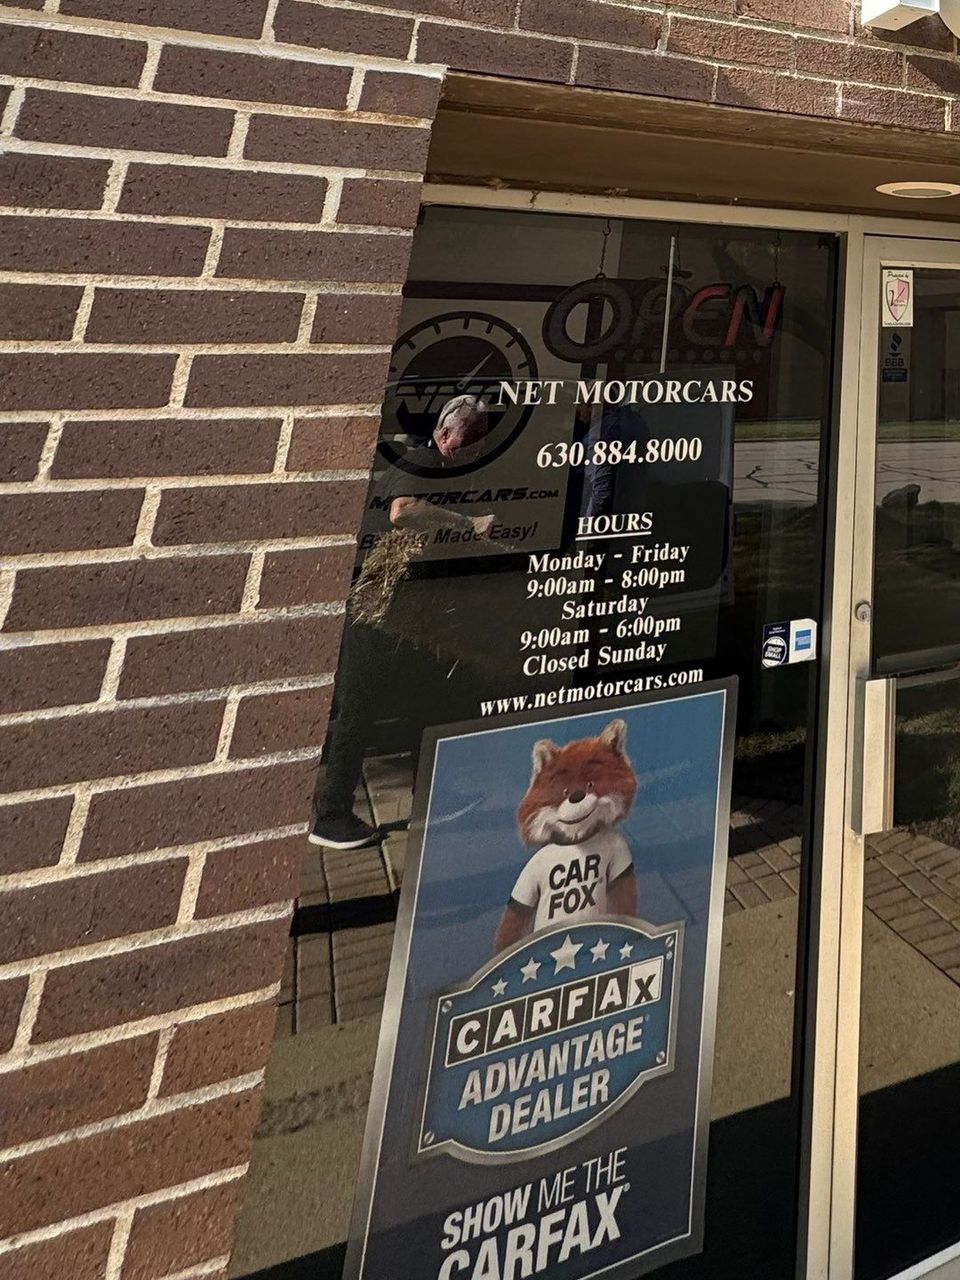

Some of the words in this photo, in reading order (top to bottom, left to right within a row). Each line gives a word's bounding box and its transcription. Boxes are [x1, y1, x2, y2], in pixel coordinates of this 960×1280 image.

[497, 381, 564, 407] NET
[573, 379, 754, 405] MOTORCARS
[536, 436, 703, 468] 630.884.8000
[488, 522, 538, 543] Easy!
[577, 512, 654, 536] HOURS
[527, 552, 605, 575] Monday
[631, 543, 690, 565] Friday
[526, 578, 595, 599] 9:00am
[621, 567, 686, 590] 8:00pm
[561, 595, 649, 620] Saturday
[520, 628, 590, 652] 9:00am
[616, 617, 681, 639] 6:00pm
[523, 646, 589, 677] Closed
[597, 641, 667, 666] Sunday
[480, 668, 704, 717] www.netmotorcars.com
[549, 854, 601, 890] CAR
[548, 881, 598, 920] FOX
[456, 973, 657, 1055] CARFAX
[457, 1016, 645, 1111] ADVANTAGE
[487, 1067, 612, 1144] DEALER
[440, 1183, 533, 1250] SHOW
[537, 1166, 577, 1213] ME
[582, 1146, 628, 1194] THE
